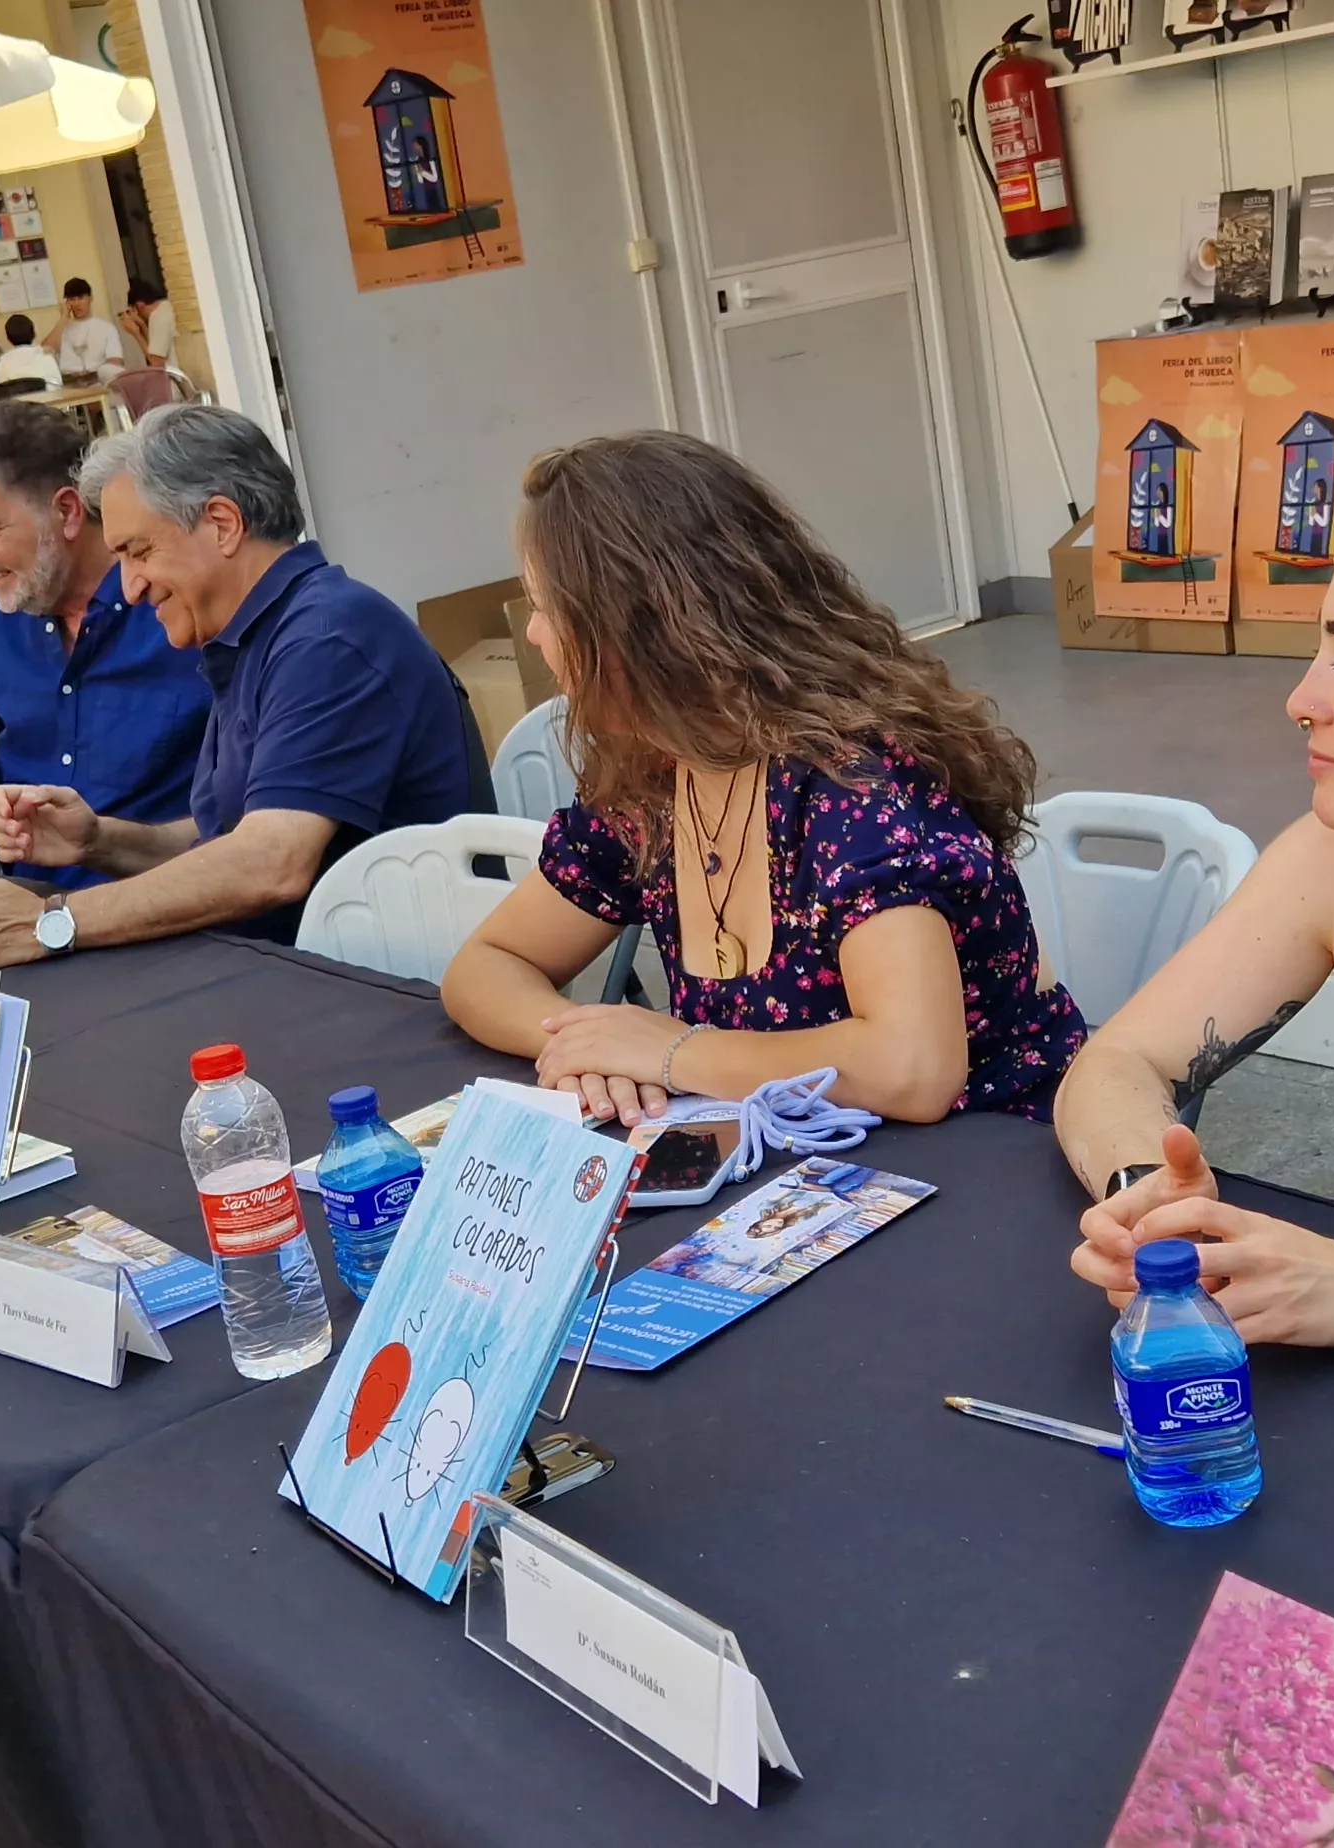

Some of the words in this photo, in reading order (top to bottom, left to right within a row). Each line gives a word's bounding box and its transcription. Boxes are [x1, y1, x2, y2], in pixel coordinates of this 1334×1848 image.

[1162, 359, 1185, 368] FERIA
[1188, 357, 1203, 366] DEL
[1207, 356, 1234, 366] LIBRO
[1184, 368, 1196, 378] DE
[1198, 367, 1234, 377] HUESCA
[391, 1188, 414, 1201] PINOS
[455, 1156, 532, 1217] RATONES
[219, 1196, 249, 1211] San
[250, 1184, 287, 1205] Millán
[453, 1215, 545, 1284] COLORADOS
[3, 1303, 22, 1320] Thays
[23, 1311, 45, 1326] Santos
[45, 1318, 54, 1330] de
[55, 1320, 67, 1334] Fez
[641, 1321, 698, 1339] LECTURA!
[1185, 1383, 1224, 1396] MONTE
[1191, 1390, 1225, 1403] PINOS
[593, 1640, 628, 1676] Susana
[630, 1664, 666, 1699] Roldán
